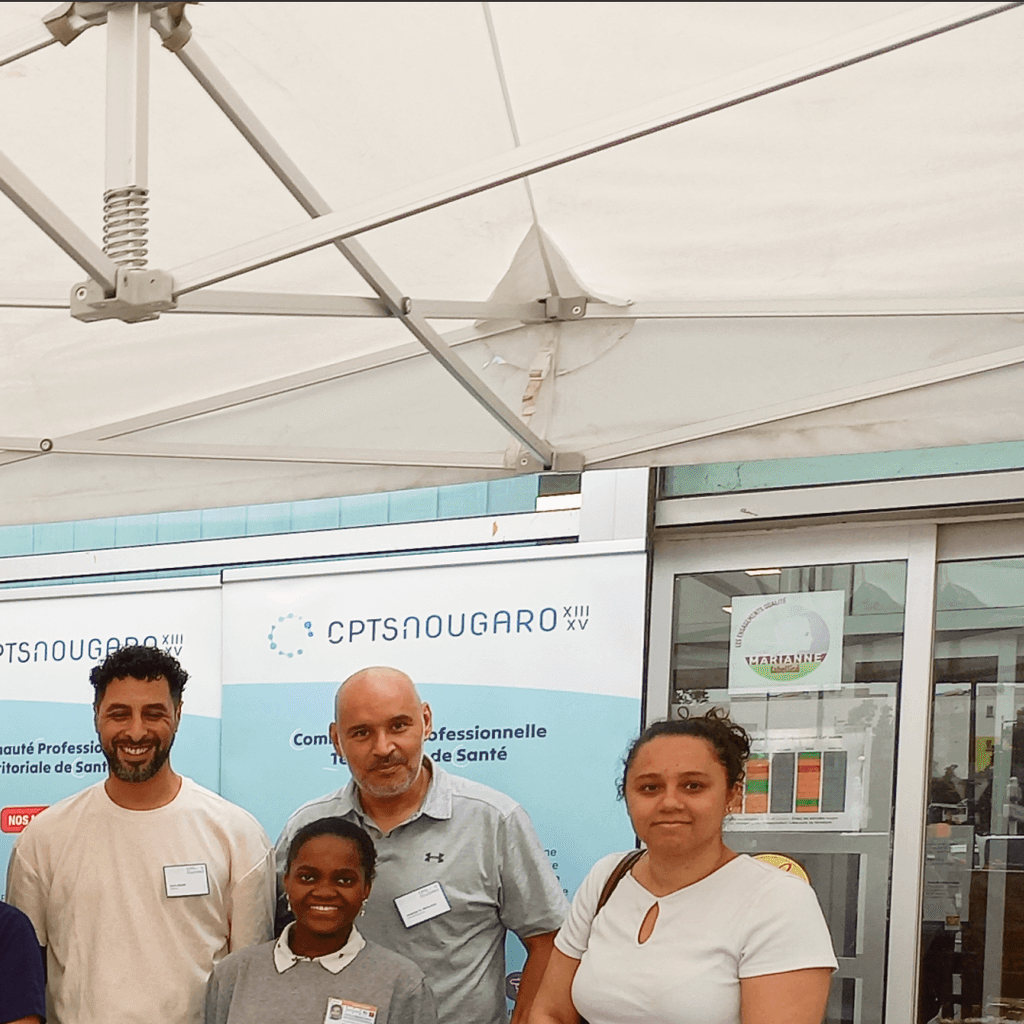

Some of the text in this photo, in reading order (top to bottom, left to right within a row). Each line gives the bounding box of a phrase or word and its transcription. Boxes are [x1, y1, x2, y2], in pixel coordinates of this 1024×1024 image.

[563, 605, 590, 618] XIII
[567, 619, 589, 631] XV
[162, 634, 183, 645] XIII
[749, 653, 822, 666] MARIANNE
[428, 724, 547, 741] ofessionnelle
[38, 740, 103, 755] Professio
[431, 746, 507, 762] de Santé
[55, 761, 72, 773] de
[76, 761, 107, 773] Sant
[8, 815, 29, 826] NOS
